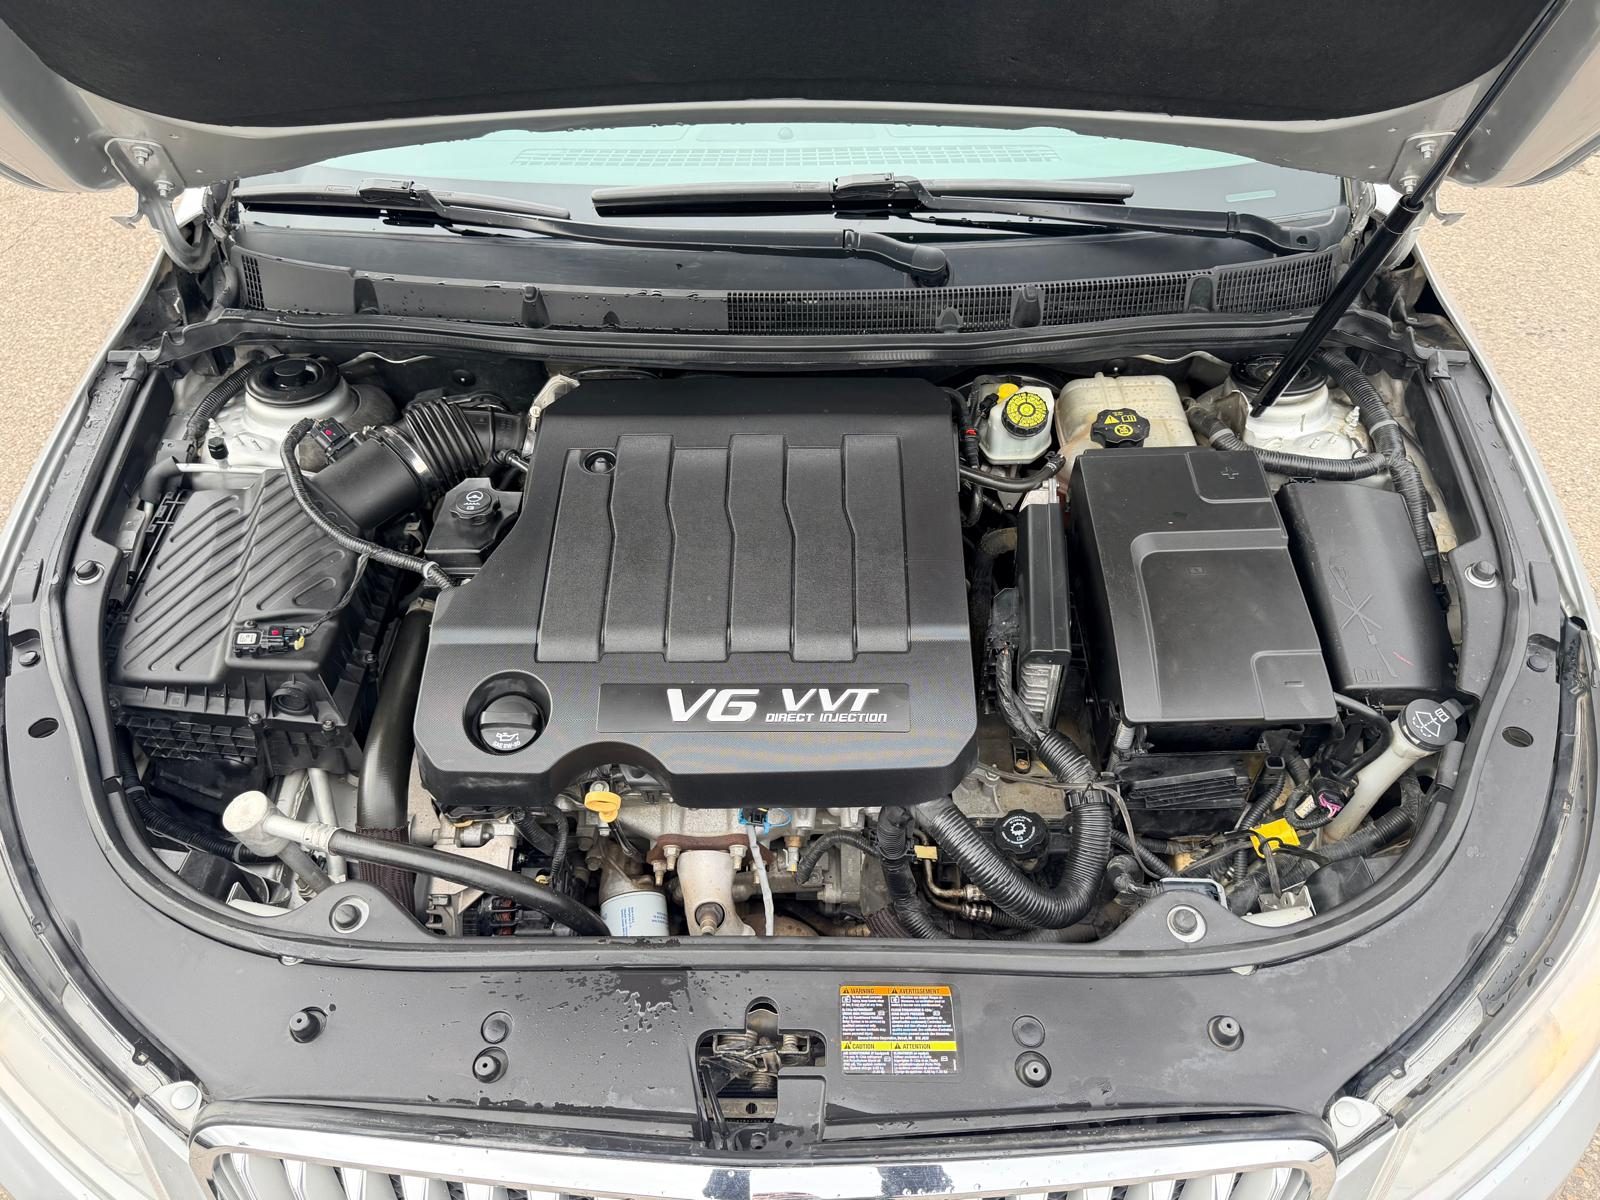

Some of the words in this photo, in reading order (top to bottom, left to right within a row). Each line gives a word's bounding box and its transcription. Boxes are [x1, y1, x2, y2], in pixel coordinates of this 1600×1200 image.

[666, 688, 760, 722] V6
[781, 688, 880, 712] VVT
[765, 713, 815, 723] DIRECT
[819, 713, 888, 723] INJECTION
